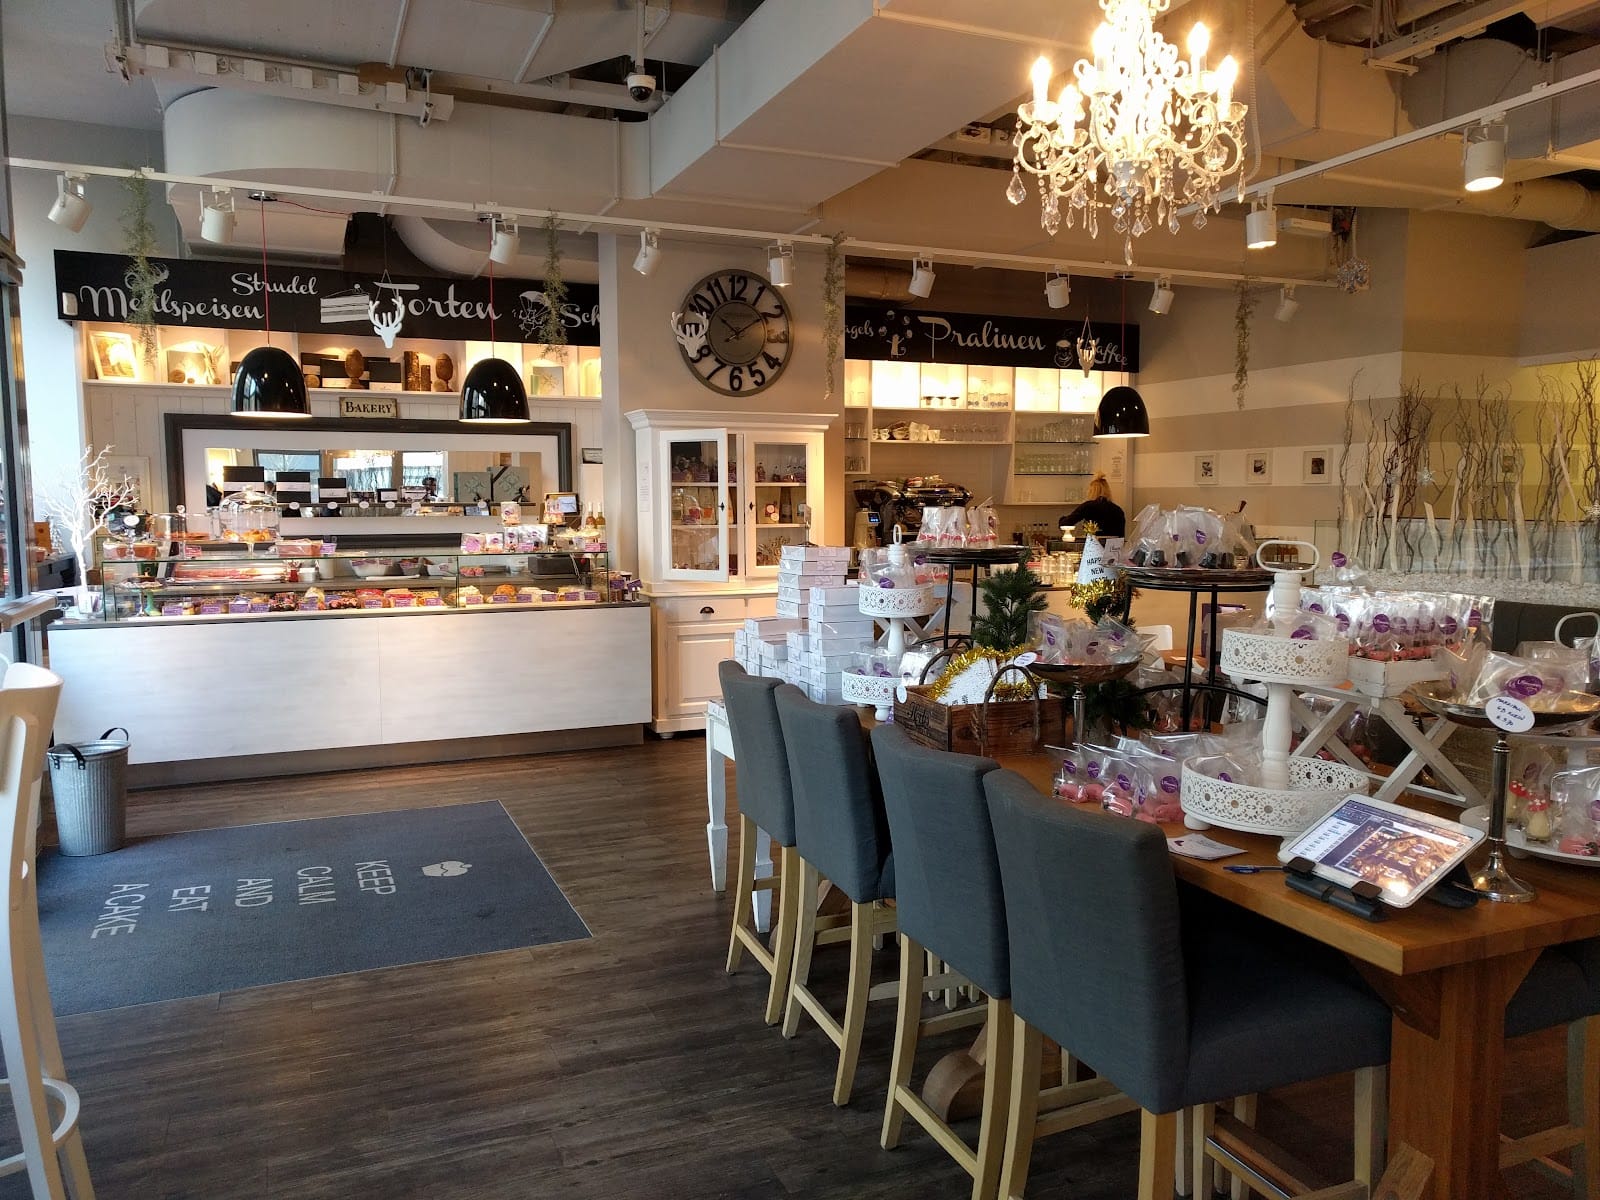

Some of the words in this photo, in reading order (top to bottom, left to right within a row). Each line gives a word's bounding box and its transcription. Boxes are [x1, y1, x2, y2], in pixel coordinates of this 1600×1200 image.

[231, 272, 318, 296] Strudel
[707, 278, 728, 306] 11
[729, 275, 748, 302] 12
[752, 285, 766, 307] 1
[760, 304, 785, 325] 2
[917, 315, 1046, 359] Pralinen
[706, 357, 727, 381] 7
[762, 351, 782, 370] 4
[729, 366, 744, 391] 6
[747, 361, 766, 387] 5
[345, 401, 393, 415] BAKERY
[296, 866, 337, 906] CALM
[355, 860, 397, 896] KEEP
[168, 885, 211, 912] EAT
[235, 878, 273, 908] AND
[91, 892, 146, 939] CAKE
